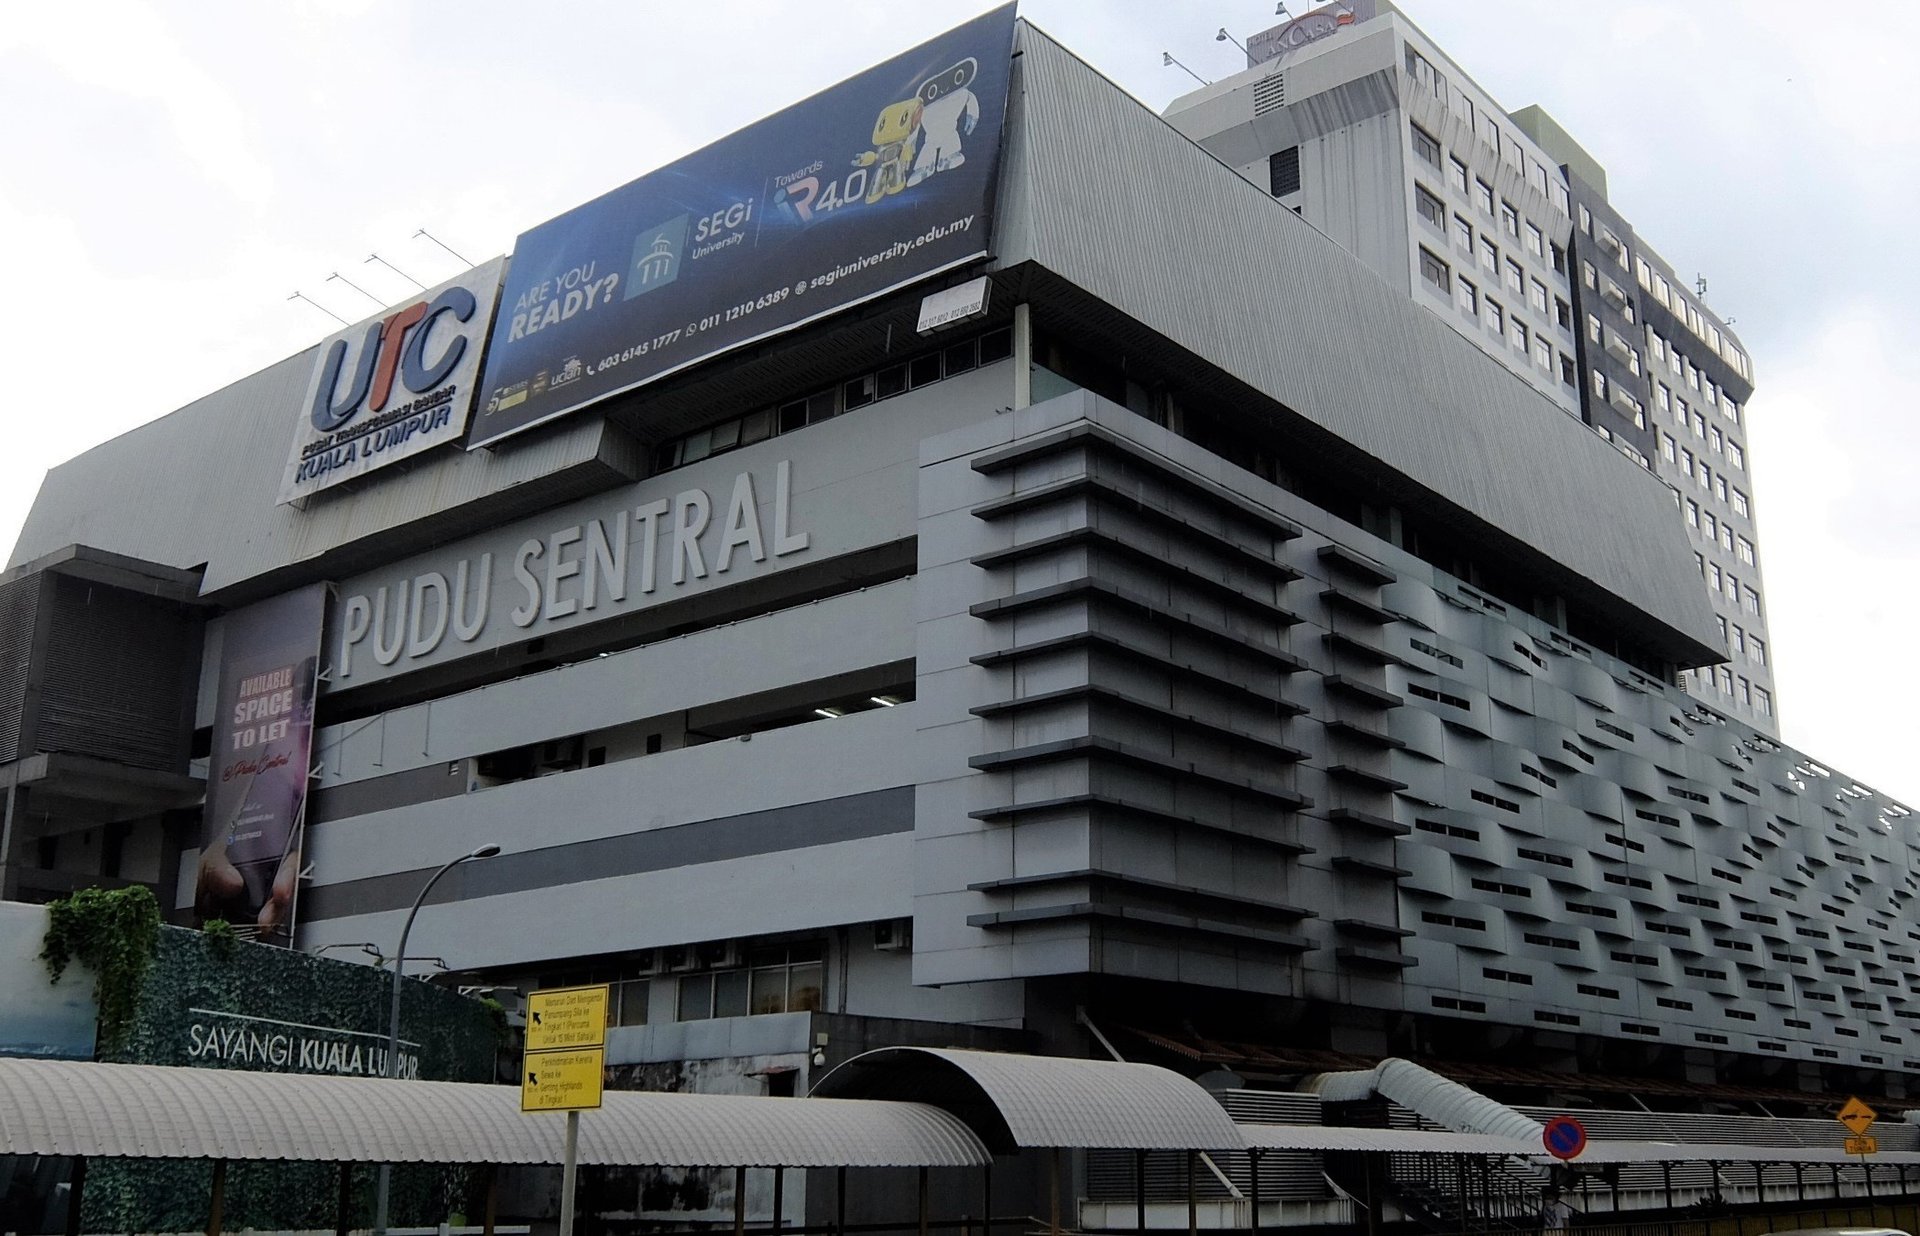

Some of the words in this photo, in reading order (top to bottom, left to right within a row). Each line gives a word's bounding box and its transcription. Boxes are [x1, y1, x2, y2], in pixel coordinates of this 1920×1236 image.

[774, 160, 823, 188] Towards
[692, 231, 745, 260] University
[507, 273, 619, 343] READY?
[514, 281, 551, 313] ARE
[556, 260, 595, 294] YOU
[598, 353, 620, 372] 603
[621, 342, 650, 363] 6145
[653, 329, 681, 350] 1777
[700, 313, 721, 332] 011
[725, 301, 755, 323] 1210
[756, 287, 790, 310] 6389
[810, 215, 974, 288] segiuniversity.edu.my
[311, 286, 477, 432] UTC
[295, 442, 356, 484] KUALA
[361, 405, 451, 457] LUMPUR
[302, 434, 334, 456] PUSAT
[339, 552, 494, 678] PUDU
[511, 460, 811, 628] SENTRAL
[234, 689, 294, 725] SPACE
[240, 667, 292, 699] AVAILABLE
[231, 728, 256, 750] TO
[259, 719, 290, 744] LET
[188, 1024, 293, 1066] SAYANGI
[300, 1038, 363, 1074] KUALA
